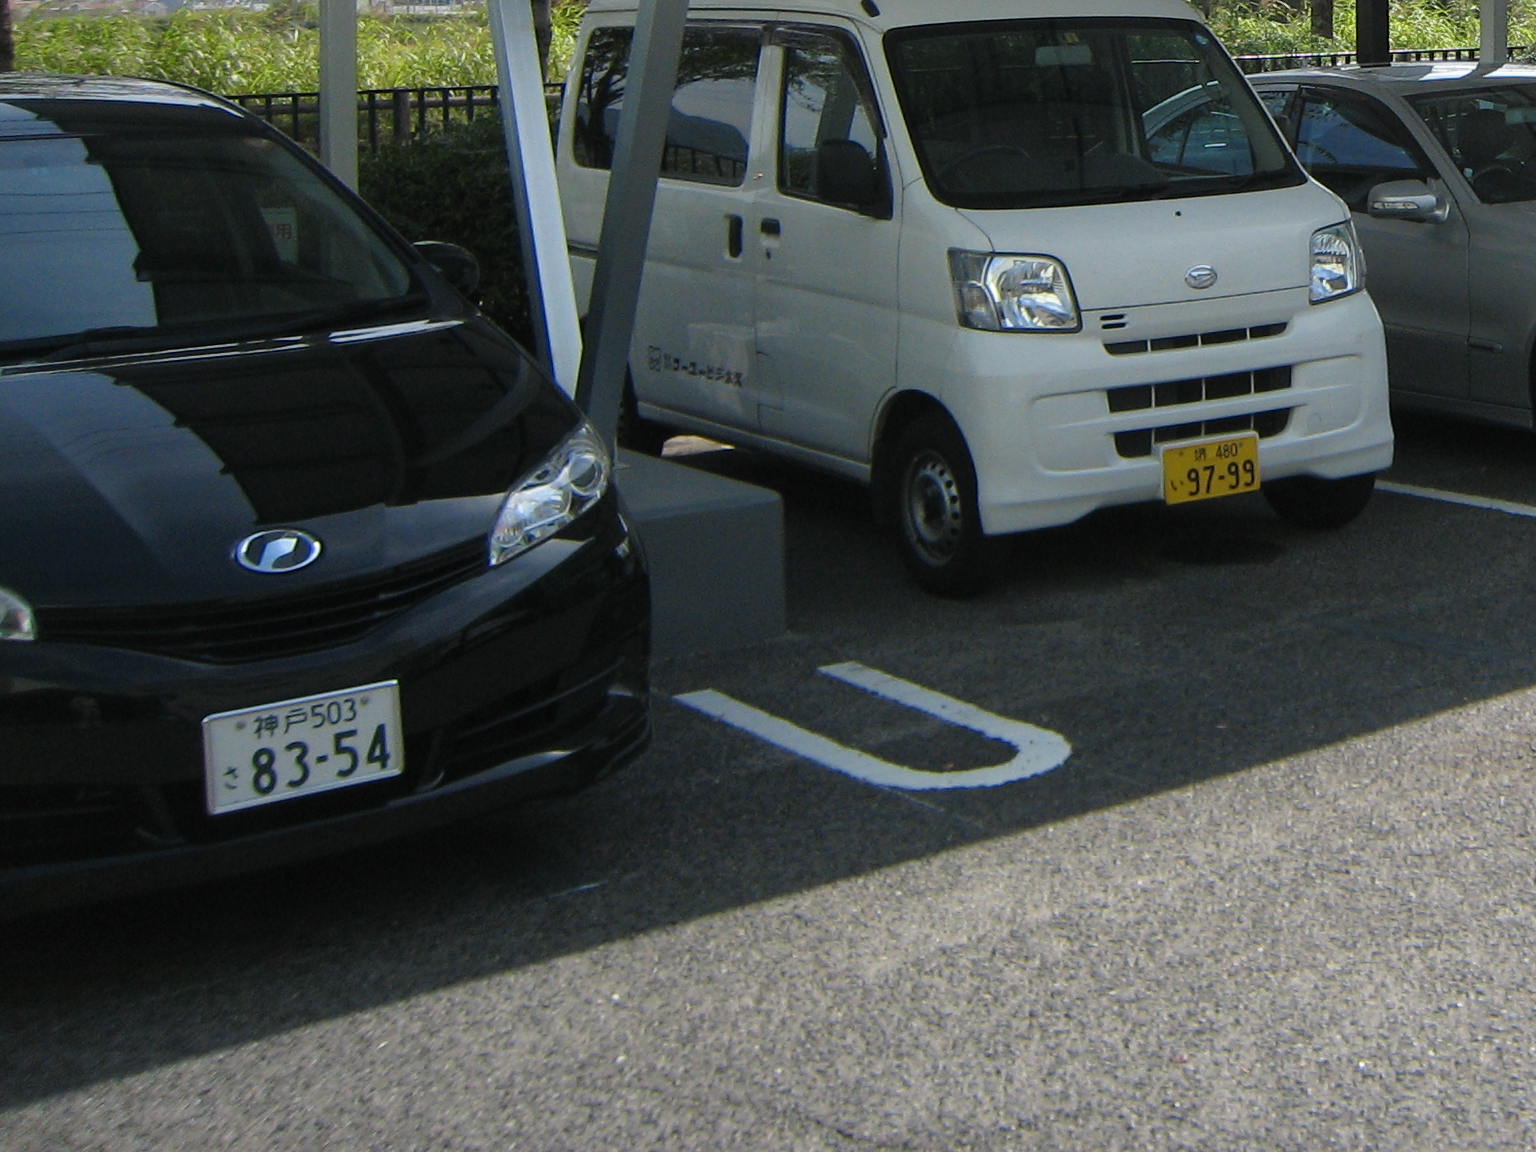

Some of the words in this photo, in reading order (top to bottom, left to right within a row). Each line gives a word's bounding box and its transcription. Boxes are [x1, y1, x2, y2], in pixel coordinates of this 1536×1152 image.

[1216, 442, 1239, 459] 480
[1169, 480, 1184, 491] い
[1187, 459, 1255, 497] 97-99
[223, 767, 239, 790] さ
[252, 724, 391, 796] 83-54
